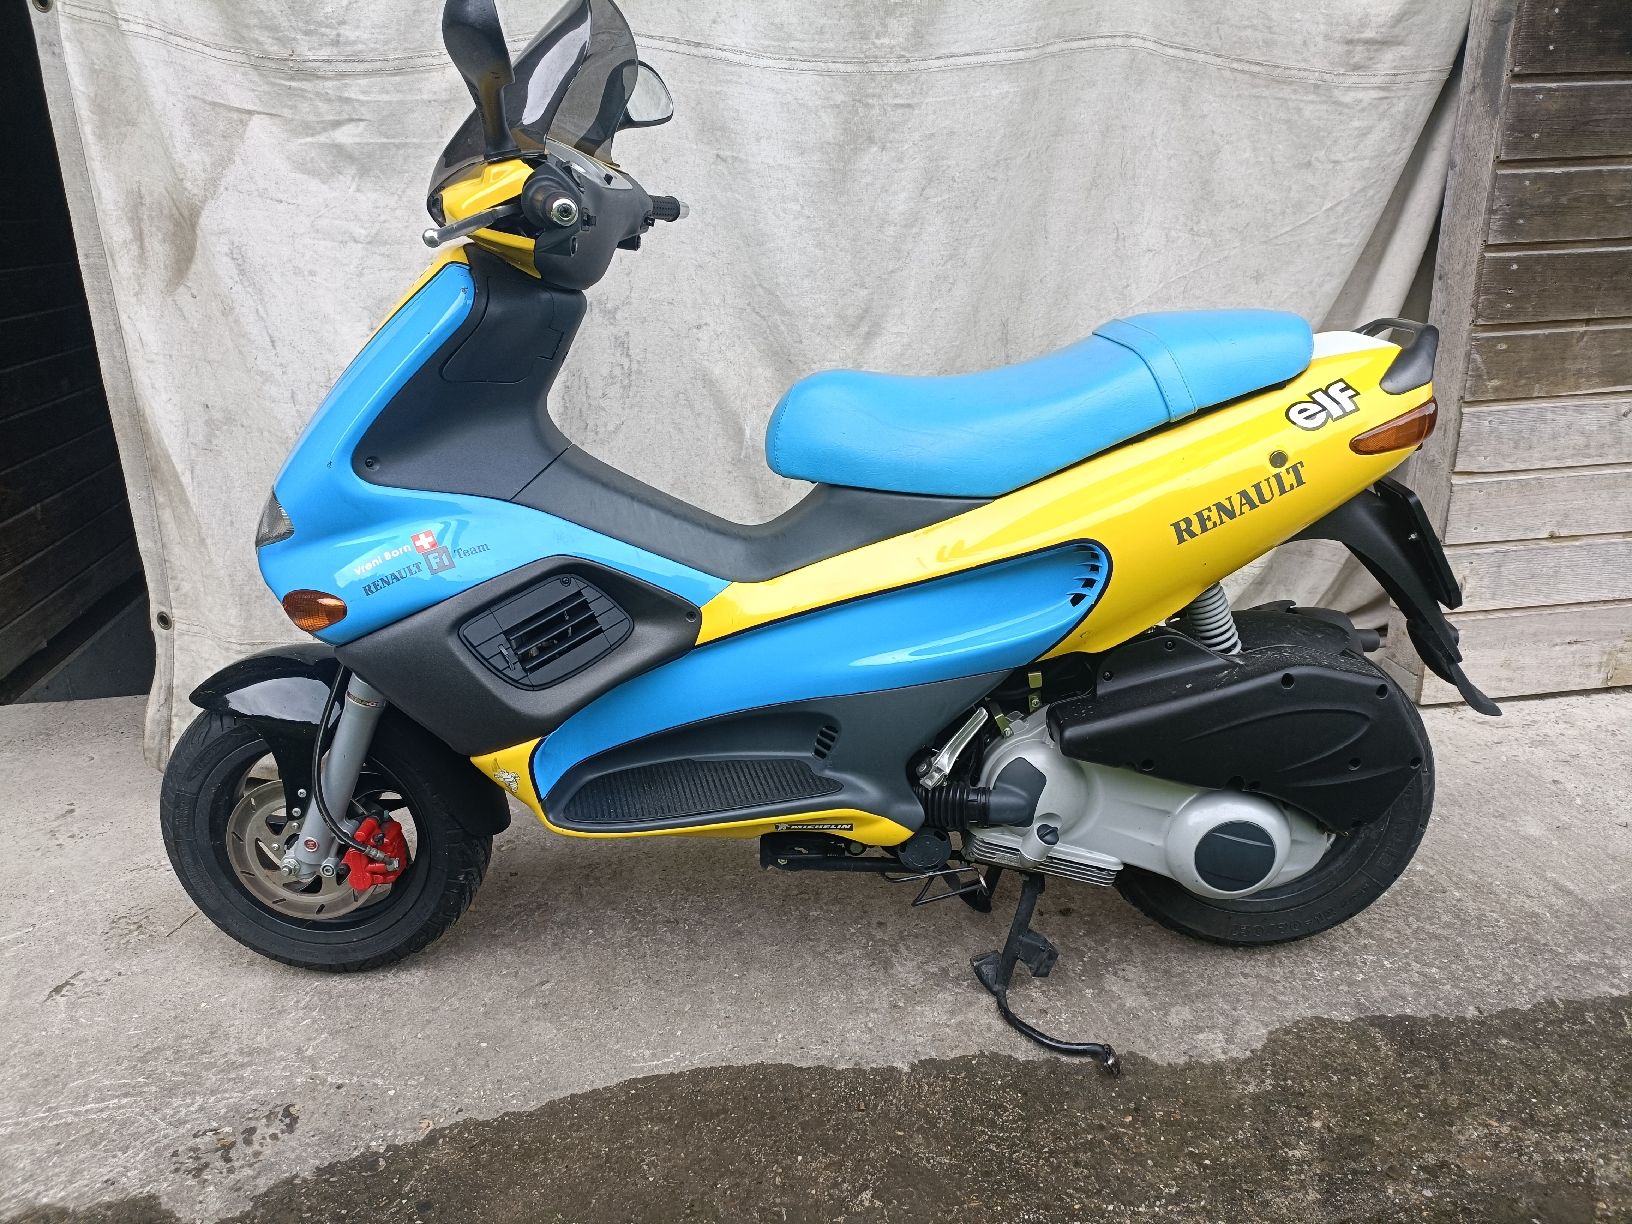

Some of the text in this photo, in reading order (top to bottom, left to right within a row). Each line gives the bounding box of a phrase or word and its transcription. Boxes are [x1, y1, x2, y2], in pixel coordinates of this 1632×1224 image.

[1285, 378, 1361, 431] elf
[1170, 461, 1306, 545] RENAULT
[362, 543, 491, 597] RENAULT F1 Team
[384, 545, 412, 560] Born
